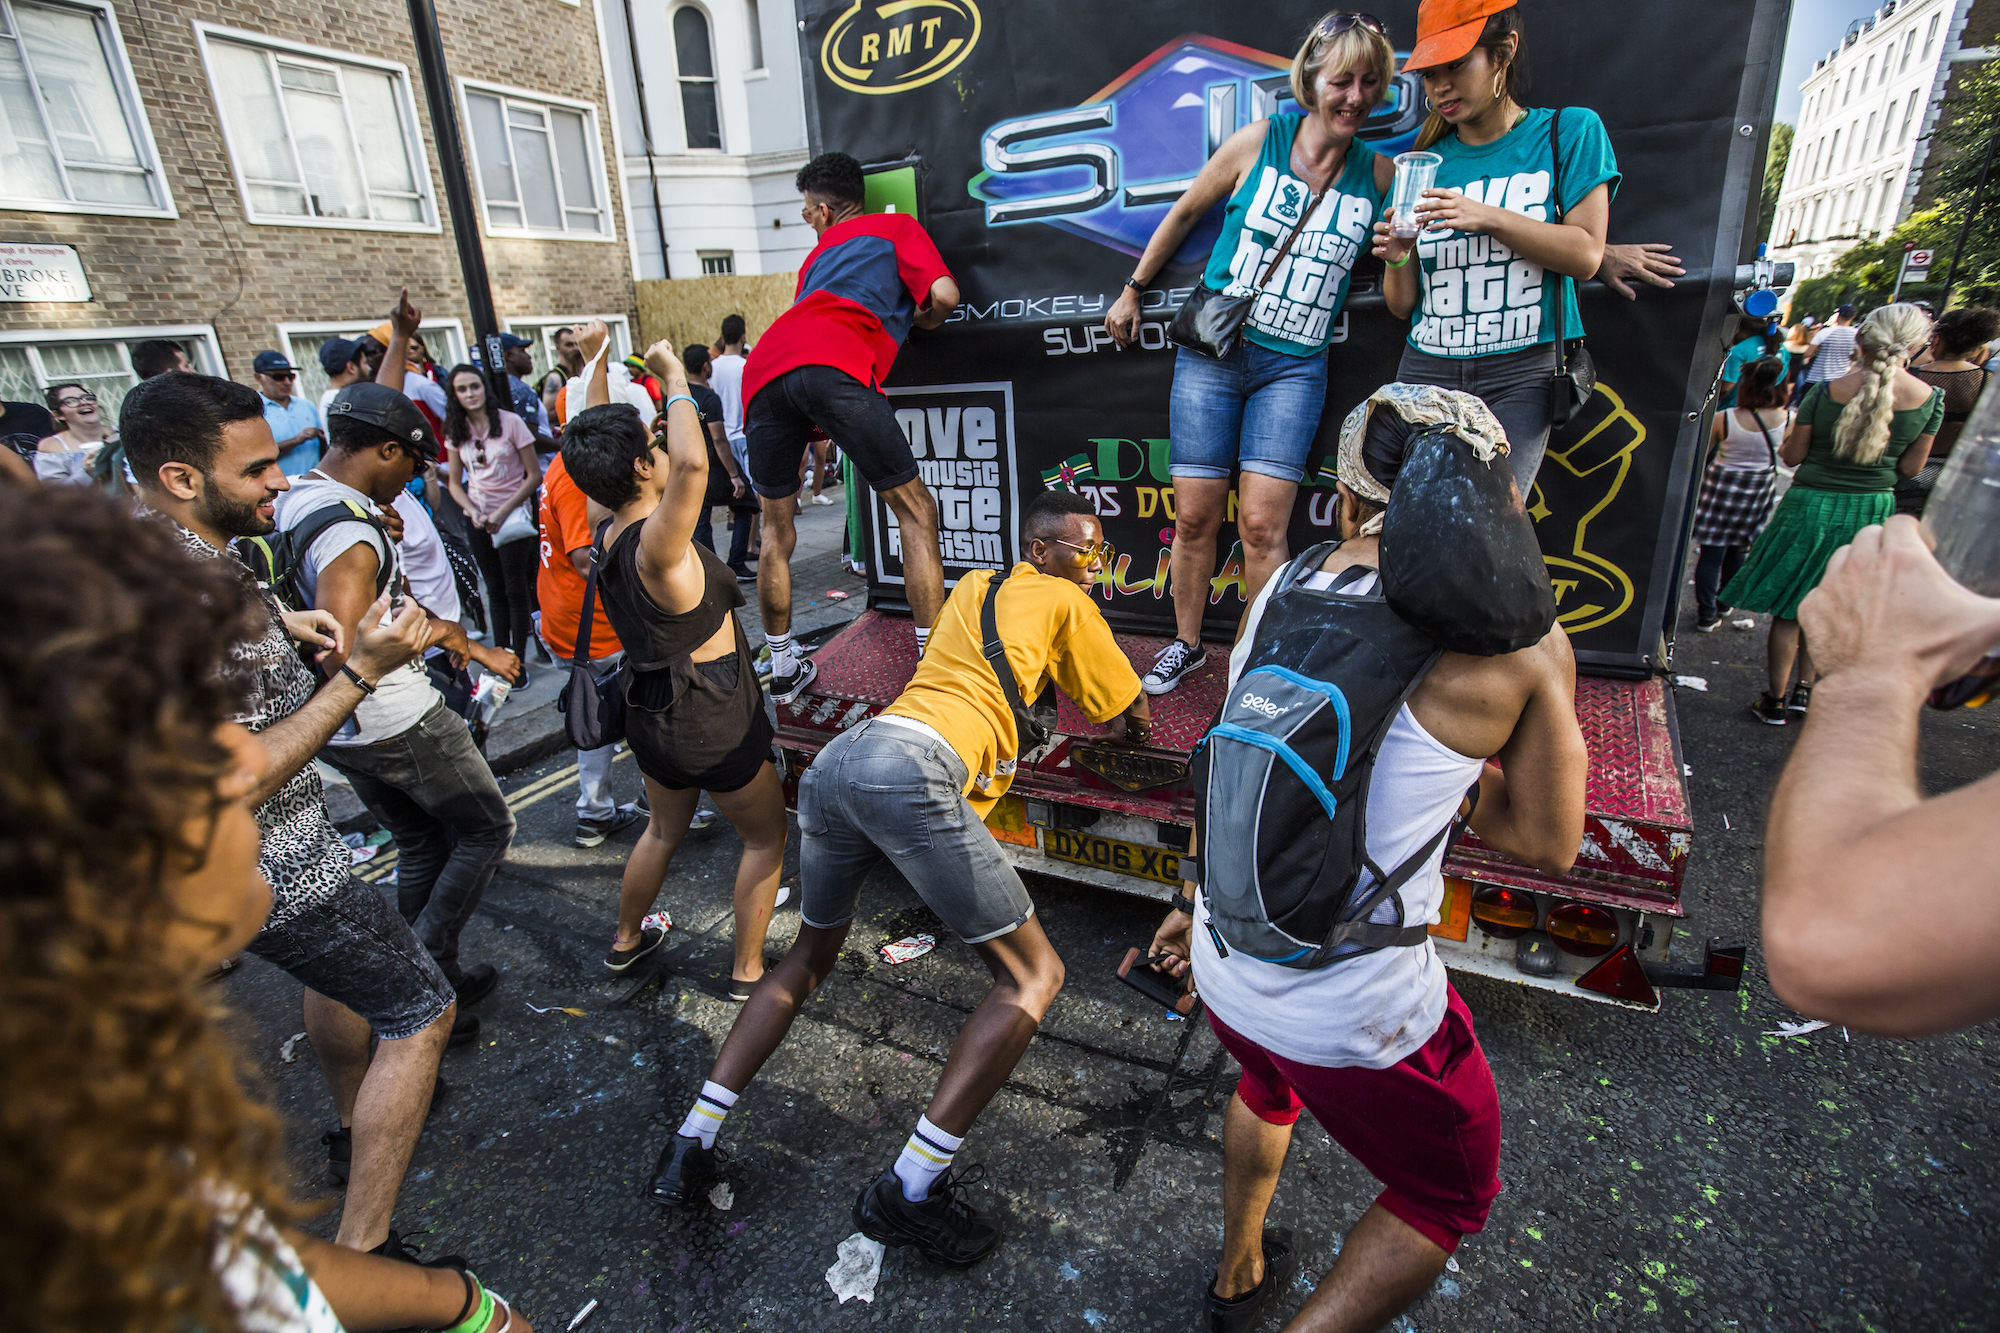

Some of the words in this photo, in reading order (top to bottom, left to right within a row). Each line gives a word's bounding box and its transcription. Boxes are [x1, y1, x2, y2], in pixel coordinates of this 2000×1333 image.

[860, 16, 941, 64] RMT
[0, 269, 70, 283] BROKE
[944, 293, 1105, 323] SMOKEY
[1448, 346, 1476, 357] UNITY
[1476, 344, 1488, 354] IS
[894, 406, 998, 459] ove
[1240, 692, 1290, 718] gelert
[1055, 829, 1131, 871] DX06
[1141, 847, 1180, 881] XG
